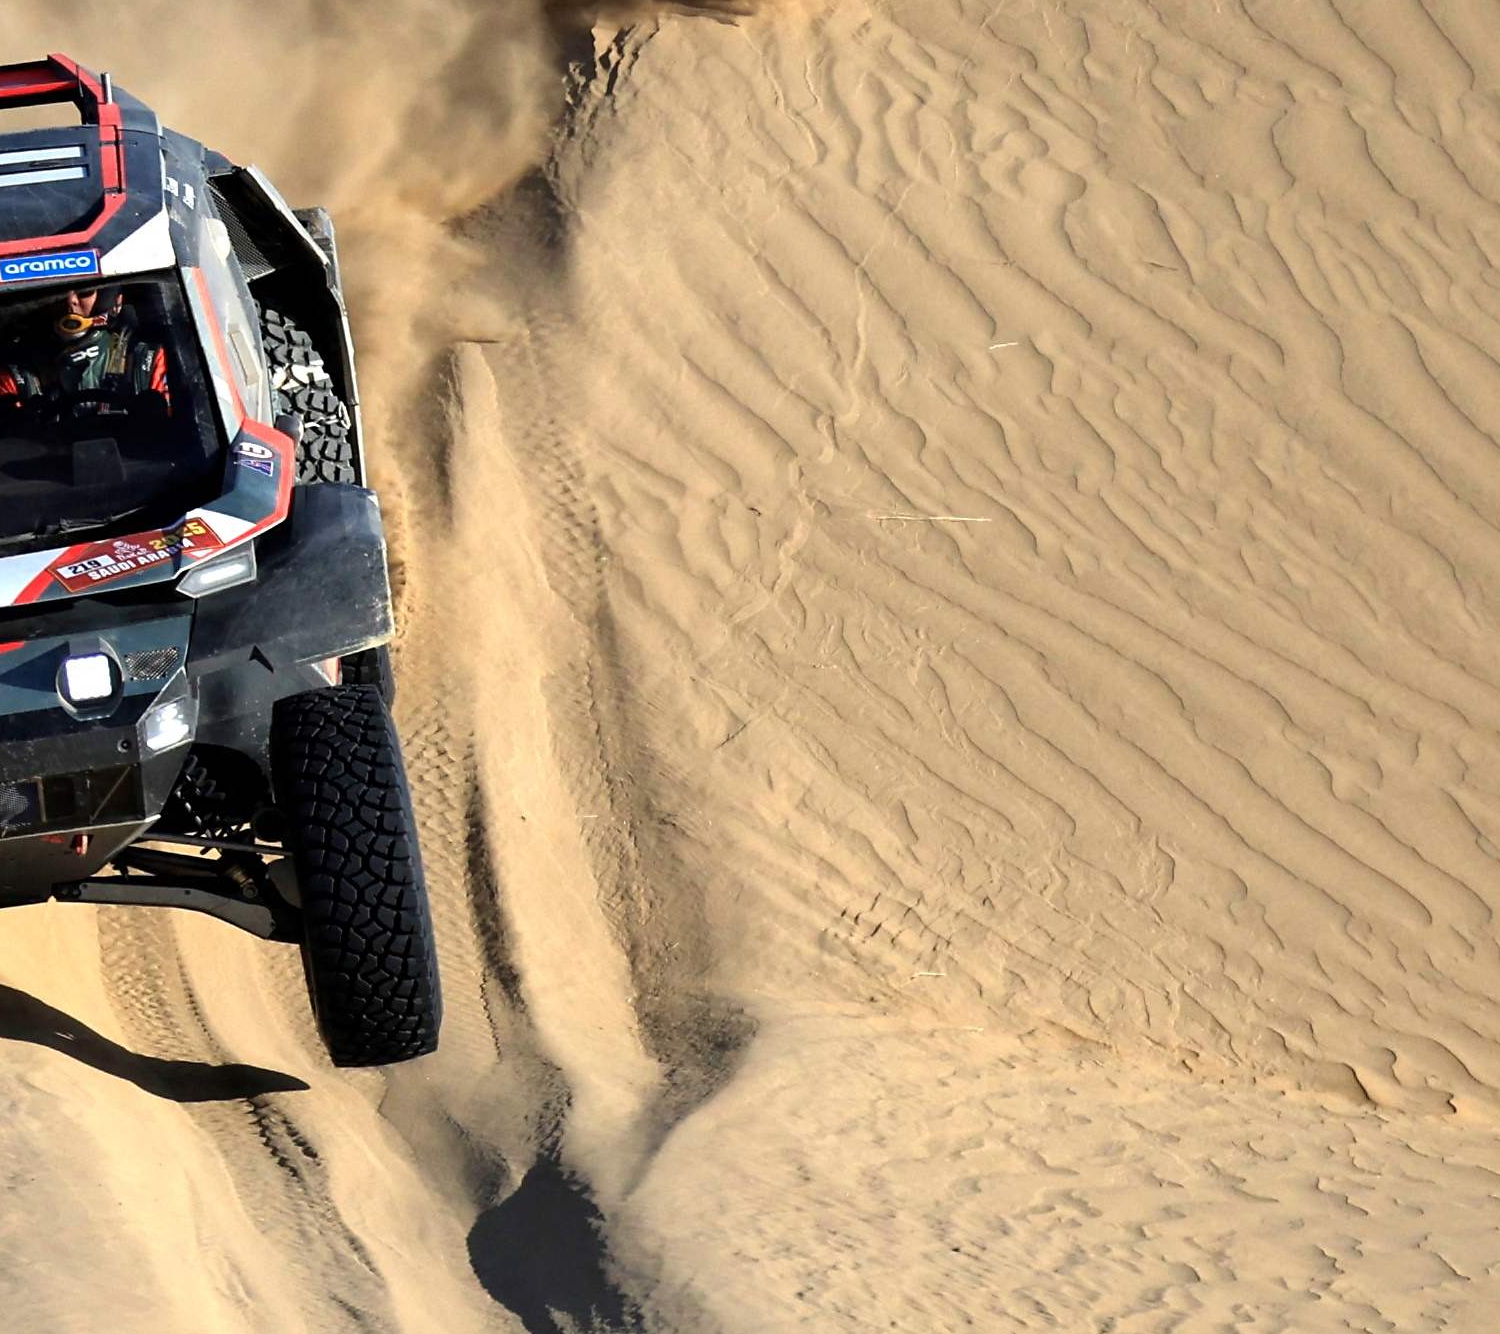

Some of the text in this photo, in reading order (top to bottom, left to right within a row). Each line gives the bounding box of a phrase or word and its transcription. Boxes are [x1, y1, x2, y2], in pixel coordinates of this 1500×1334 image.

[4, 256, 91, 274] aramco
[67, 560, 101, 575] 219
[88, 538, 195, 581] SAUDI ARABIA
